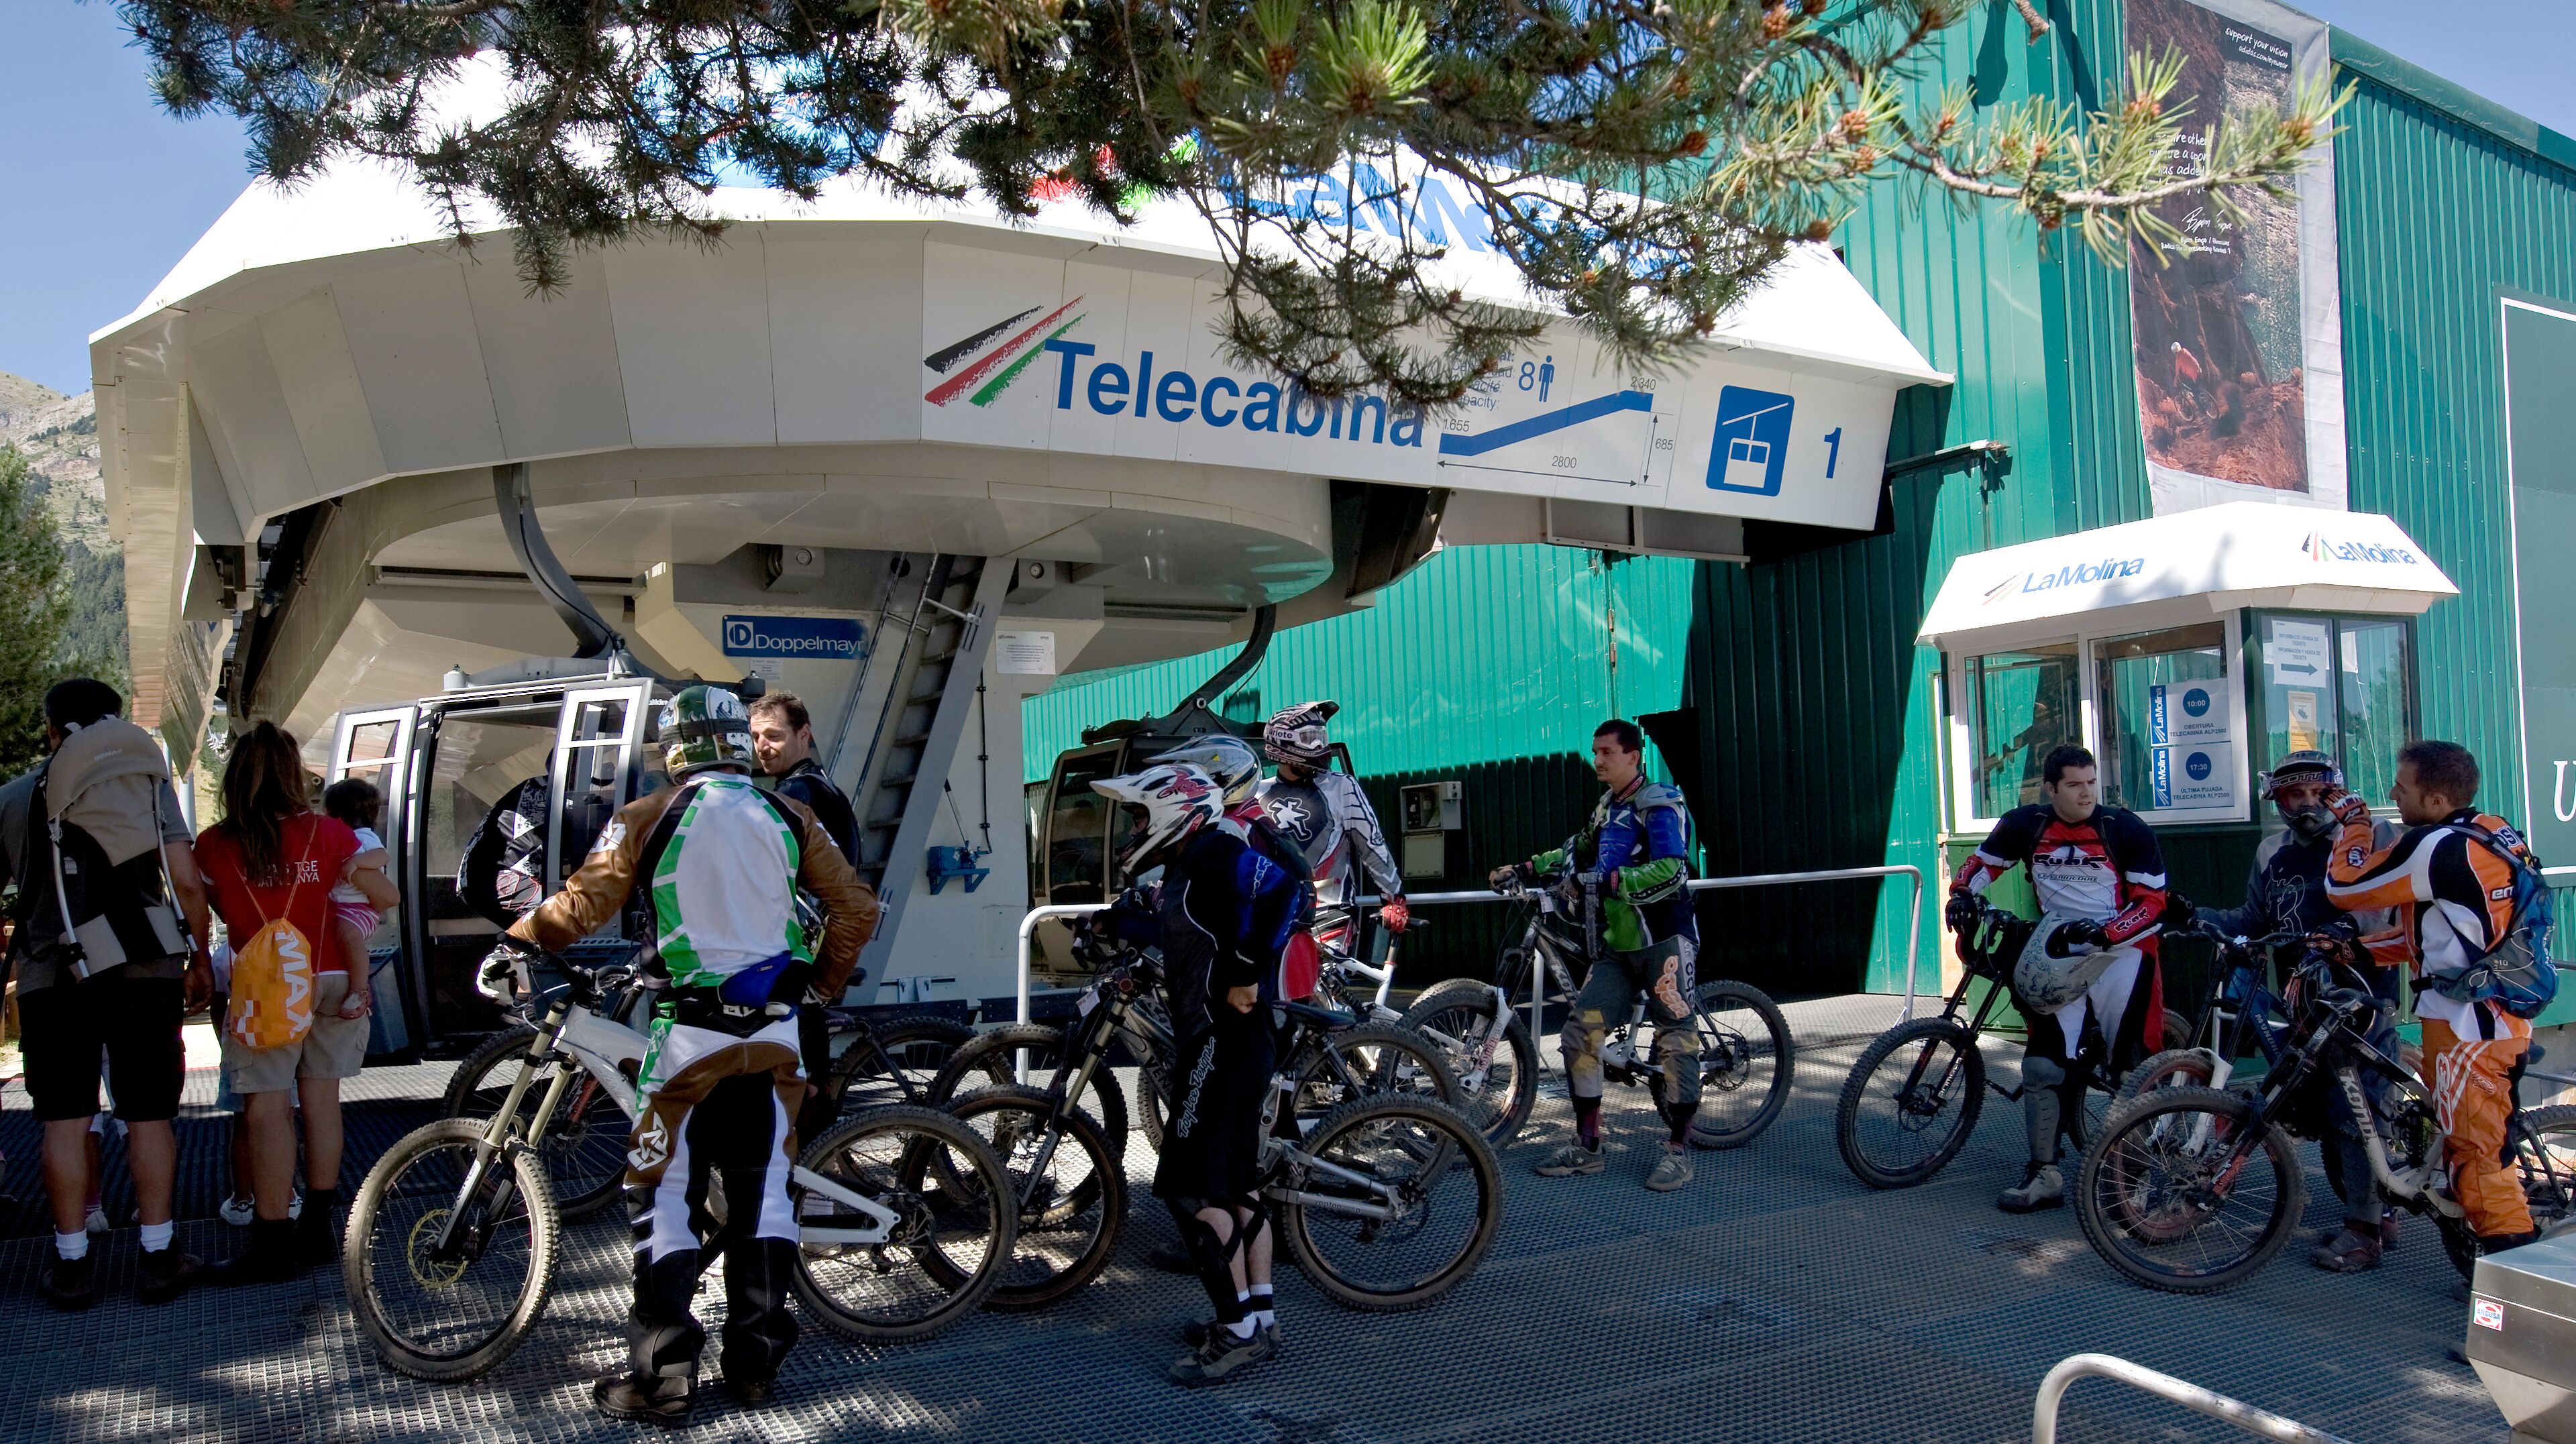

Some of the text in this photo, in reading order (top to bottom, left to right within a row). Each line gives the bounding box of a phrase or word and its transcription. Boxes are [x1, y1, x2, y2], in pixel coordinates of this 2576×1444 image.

[2225, 27, 2289, 58] support your vision
[1518, 361, 1536, 391] 8
[1631, 376, 1656, 390] 2.340
[1044, 339, 1424, 449] Telecabina
[1444, 418, 1470, 433] 1.655
[1655, 438, 1674, 450] 685
[1823, 427, 1843, 479] 1
[1551, 455, 1577, 469] 2800
[755, 634, 865, 655] Doppelmayr
[2186, 700, 2206, 708] 10:00
[1269, 728, 1293, 738] ariete
[2169, 728, 2204, 737] TELECABINA
[2271, 772, 2324, 789] SCOTT
[274, 931, 313, 1040] MAX
[1177, 1036, 1216, 1138] Troy Lee Designs
[2339, 1068, 2378, 1141] KONA
